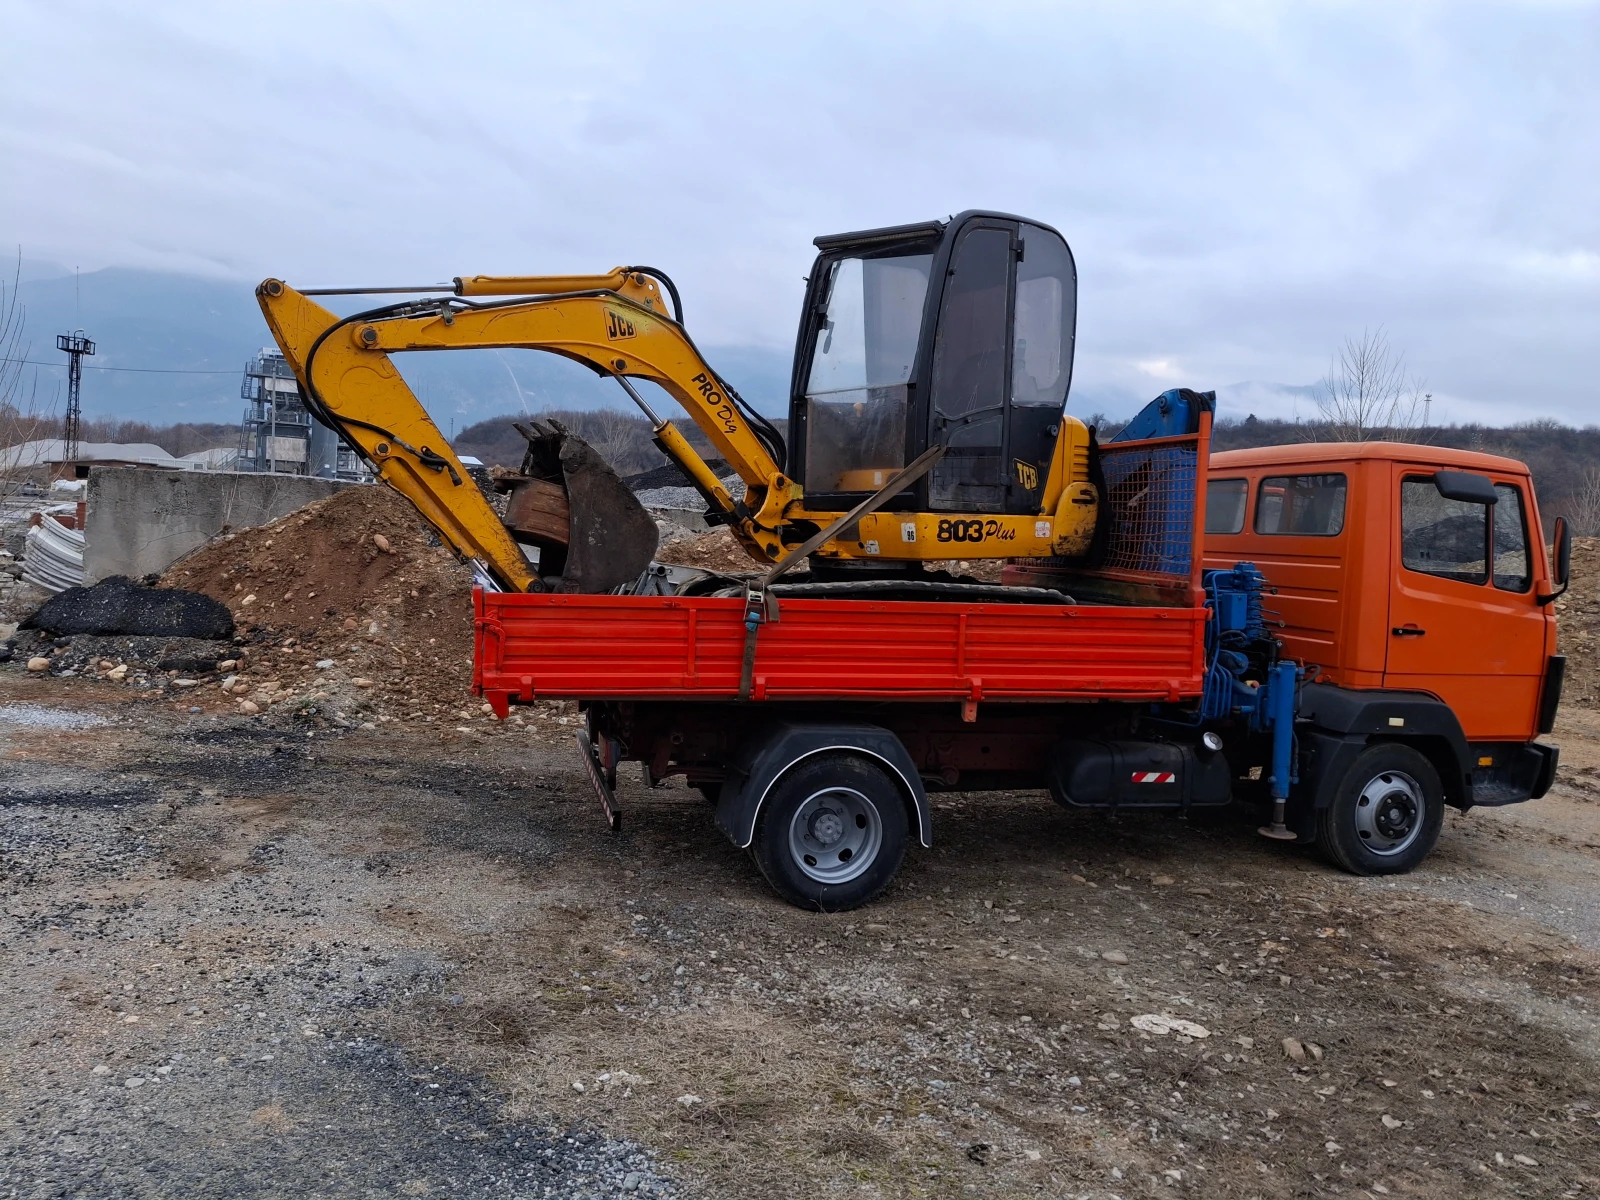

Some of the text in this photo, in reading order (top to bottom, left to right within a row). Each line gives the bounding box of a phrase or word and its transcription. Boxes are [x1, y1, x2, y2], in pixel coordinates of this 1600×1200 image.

[608, 311, 635, 338] JCB
[691, 372, 738, 434] PRO Dig
[936, 519, 984, 542] 803
[983, 520, 1016, 542] Plus
